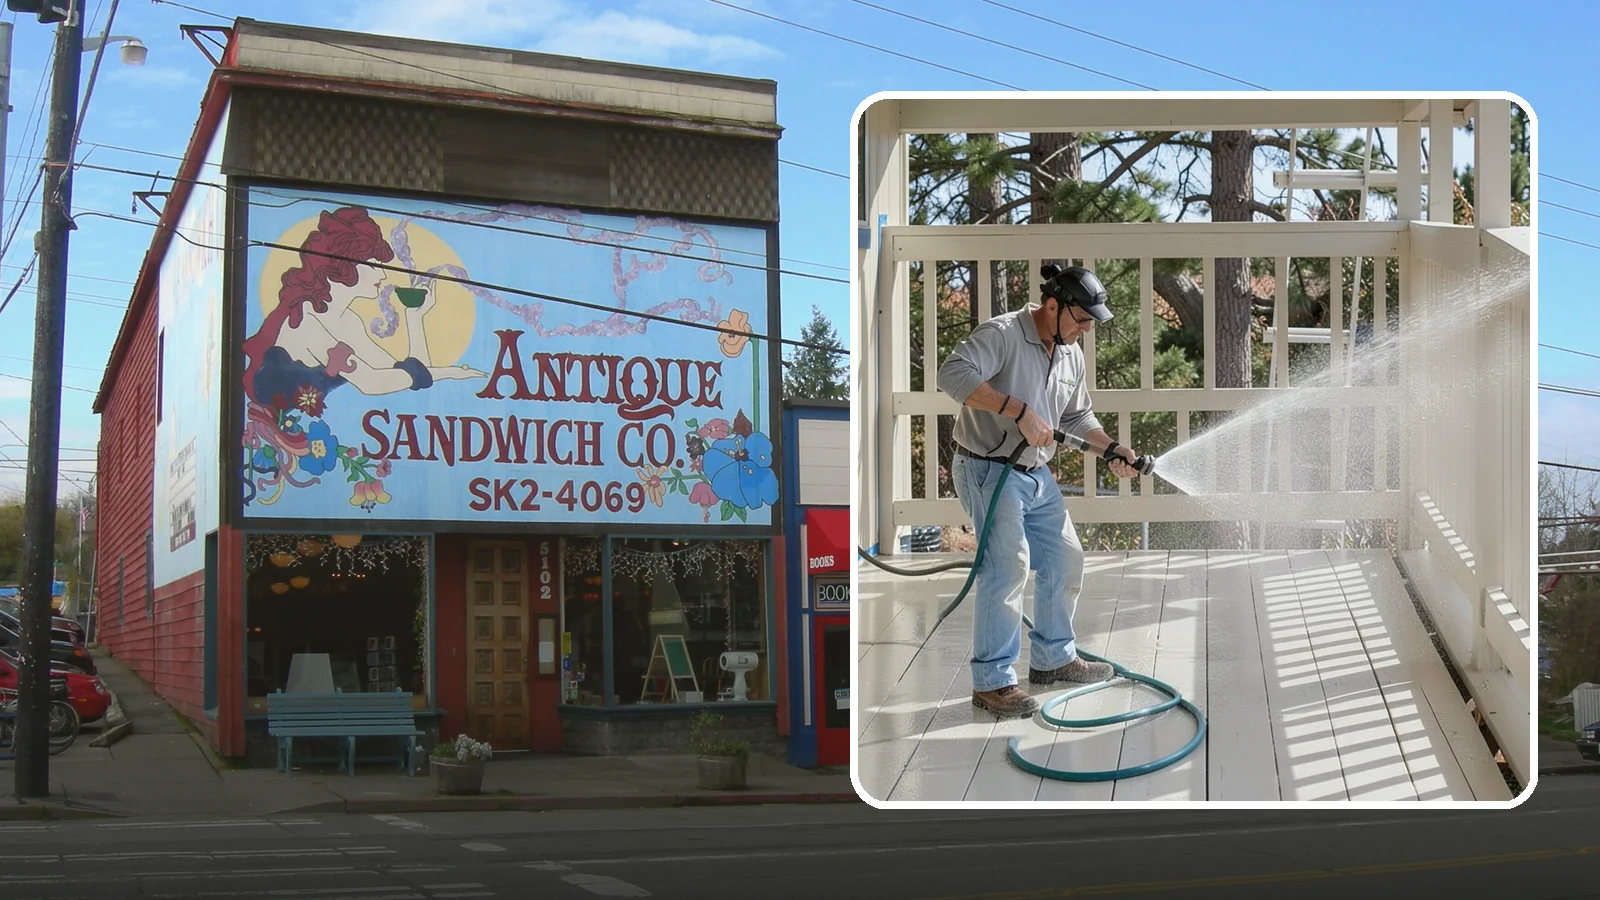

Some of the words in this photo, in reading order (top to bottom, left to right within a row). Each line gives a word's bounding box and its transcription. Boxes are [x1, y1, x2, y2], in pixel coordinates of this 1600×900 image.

[476, 328, 723, 420] ANTIQUE
[361, 408, 604, 467] SANDWICH
[617, 421, 685, 468] CO.
[468, 477, 646, 513] SK2-4069
[540, 541, 551, 600] 5102
[809, 555, 835, 569] BOOKS
